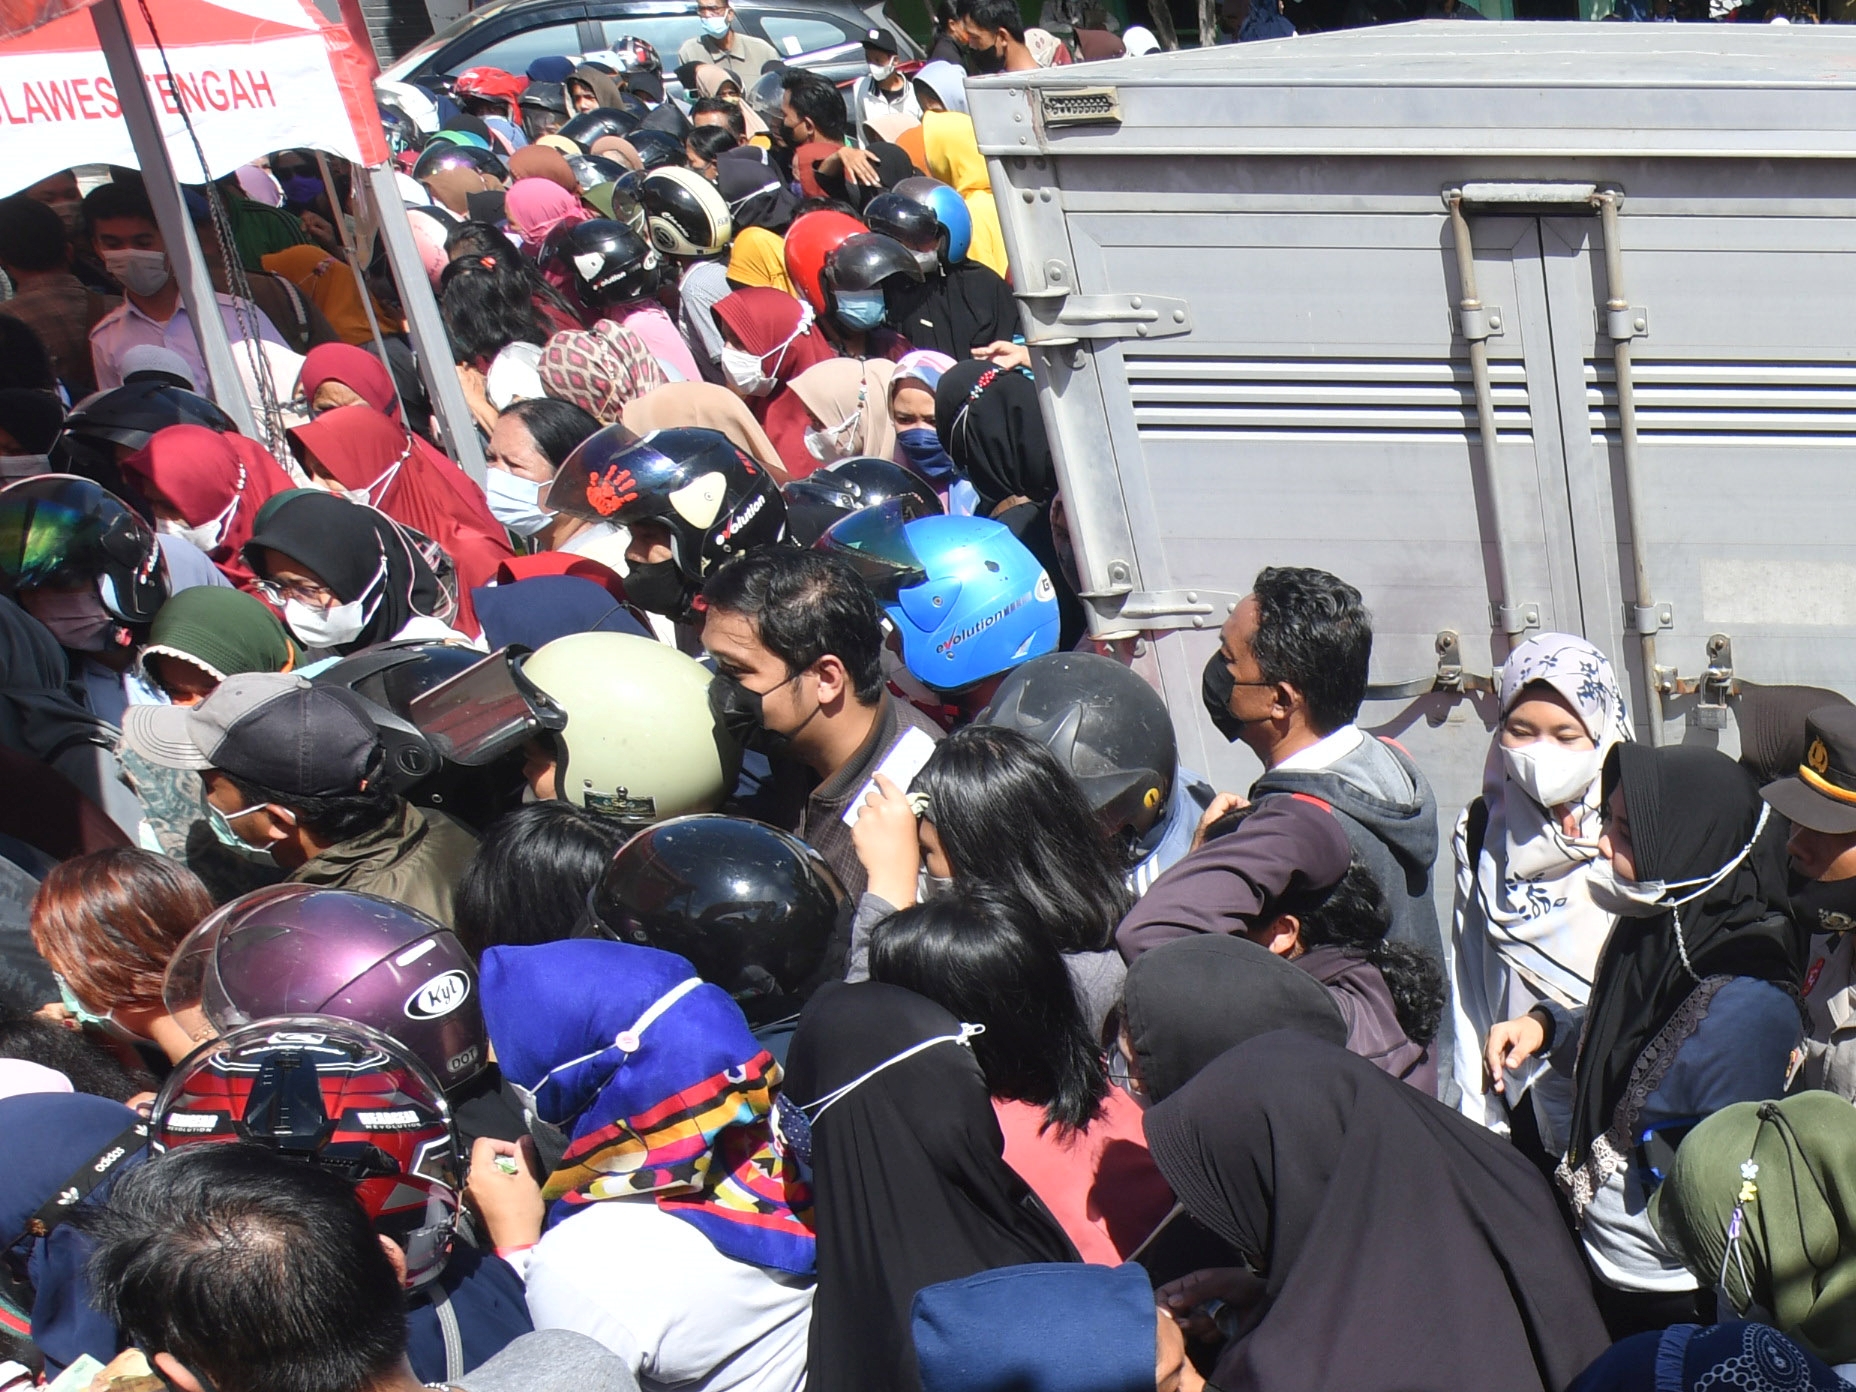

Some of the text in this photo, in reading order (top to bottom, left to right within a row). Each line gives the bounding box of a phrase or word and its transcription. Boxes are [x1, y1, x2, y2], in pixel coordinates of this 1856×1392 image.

[0, 69, 277, 125] LAWES ENGAH
[936, 608, 1006, 654] evolution
[451, 1048, 476, 1070] DOT
